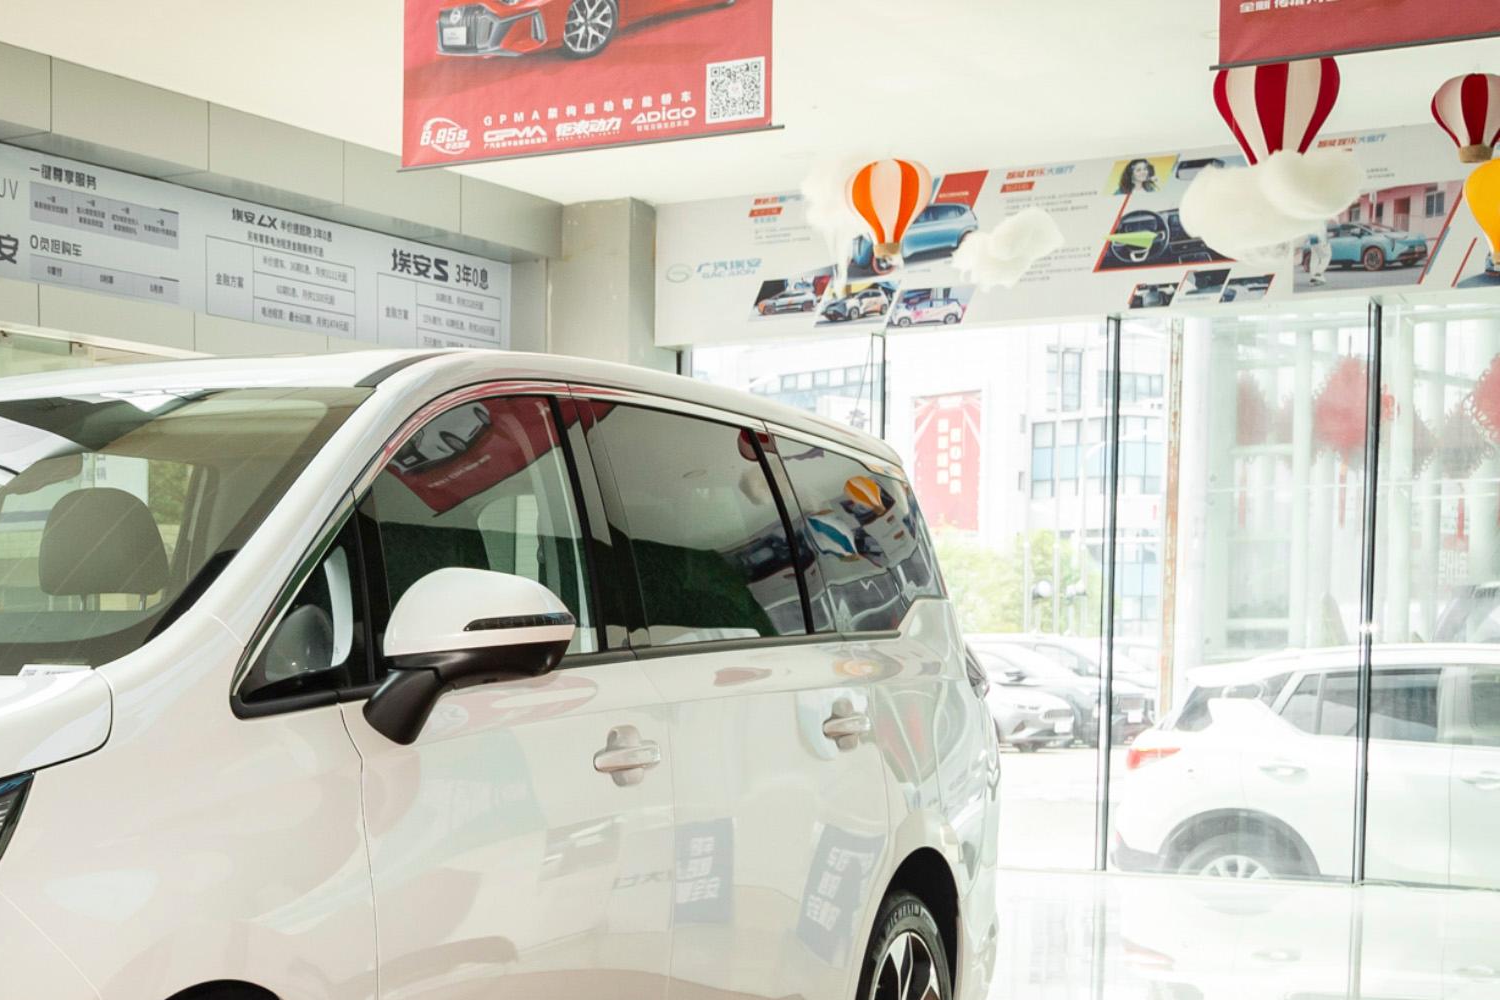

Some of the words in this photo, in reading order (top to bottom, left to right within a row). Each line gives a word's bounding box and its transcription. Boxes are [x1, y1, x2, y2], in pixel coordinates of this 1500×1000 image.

[215, 272, 245, 289] 金融方案
[455, 264, 489, 290] 3年0息
